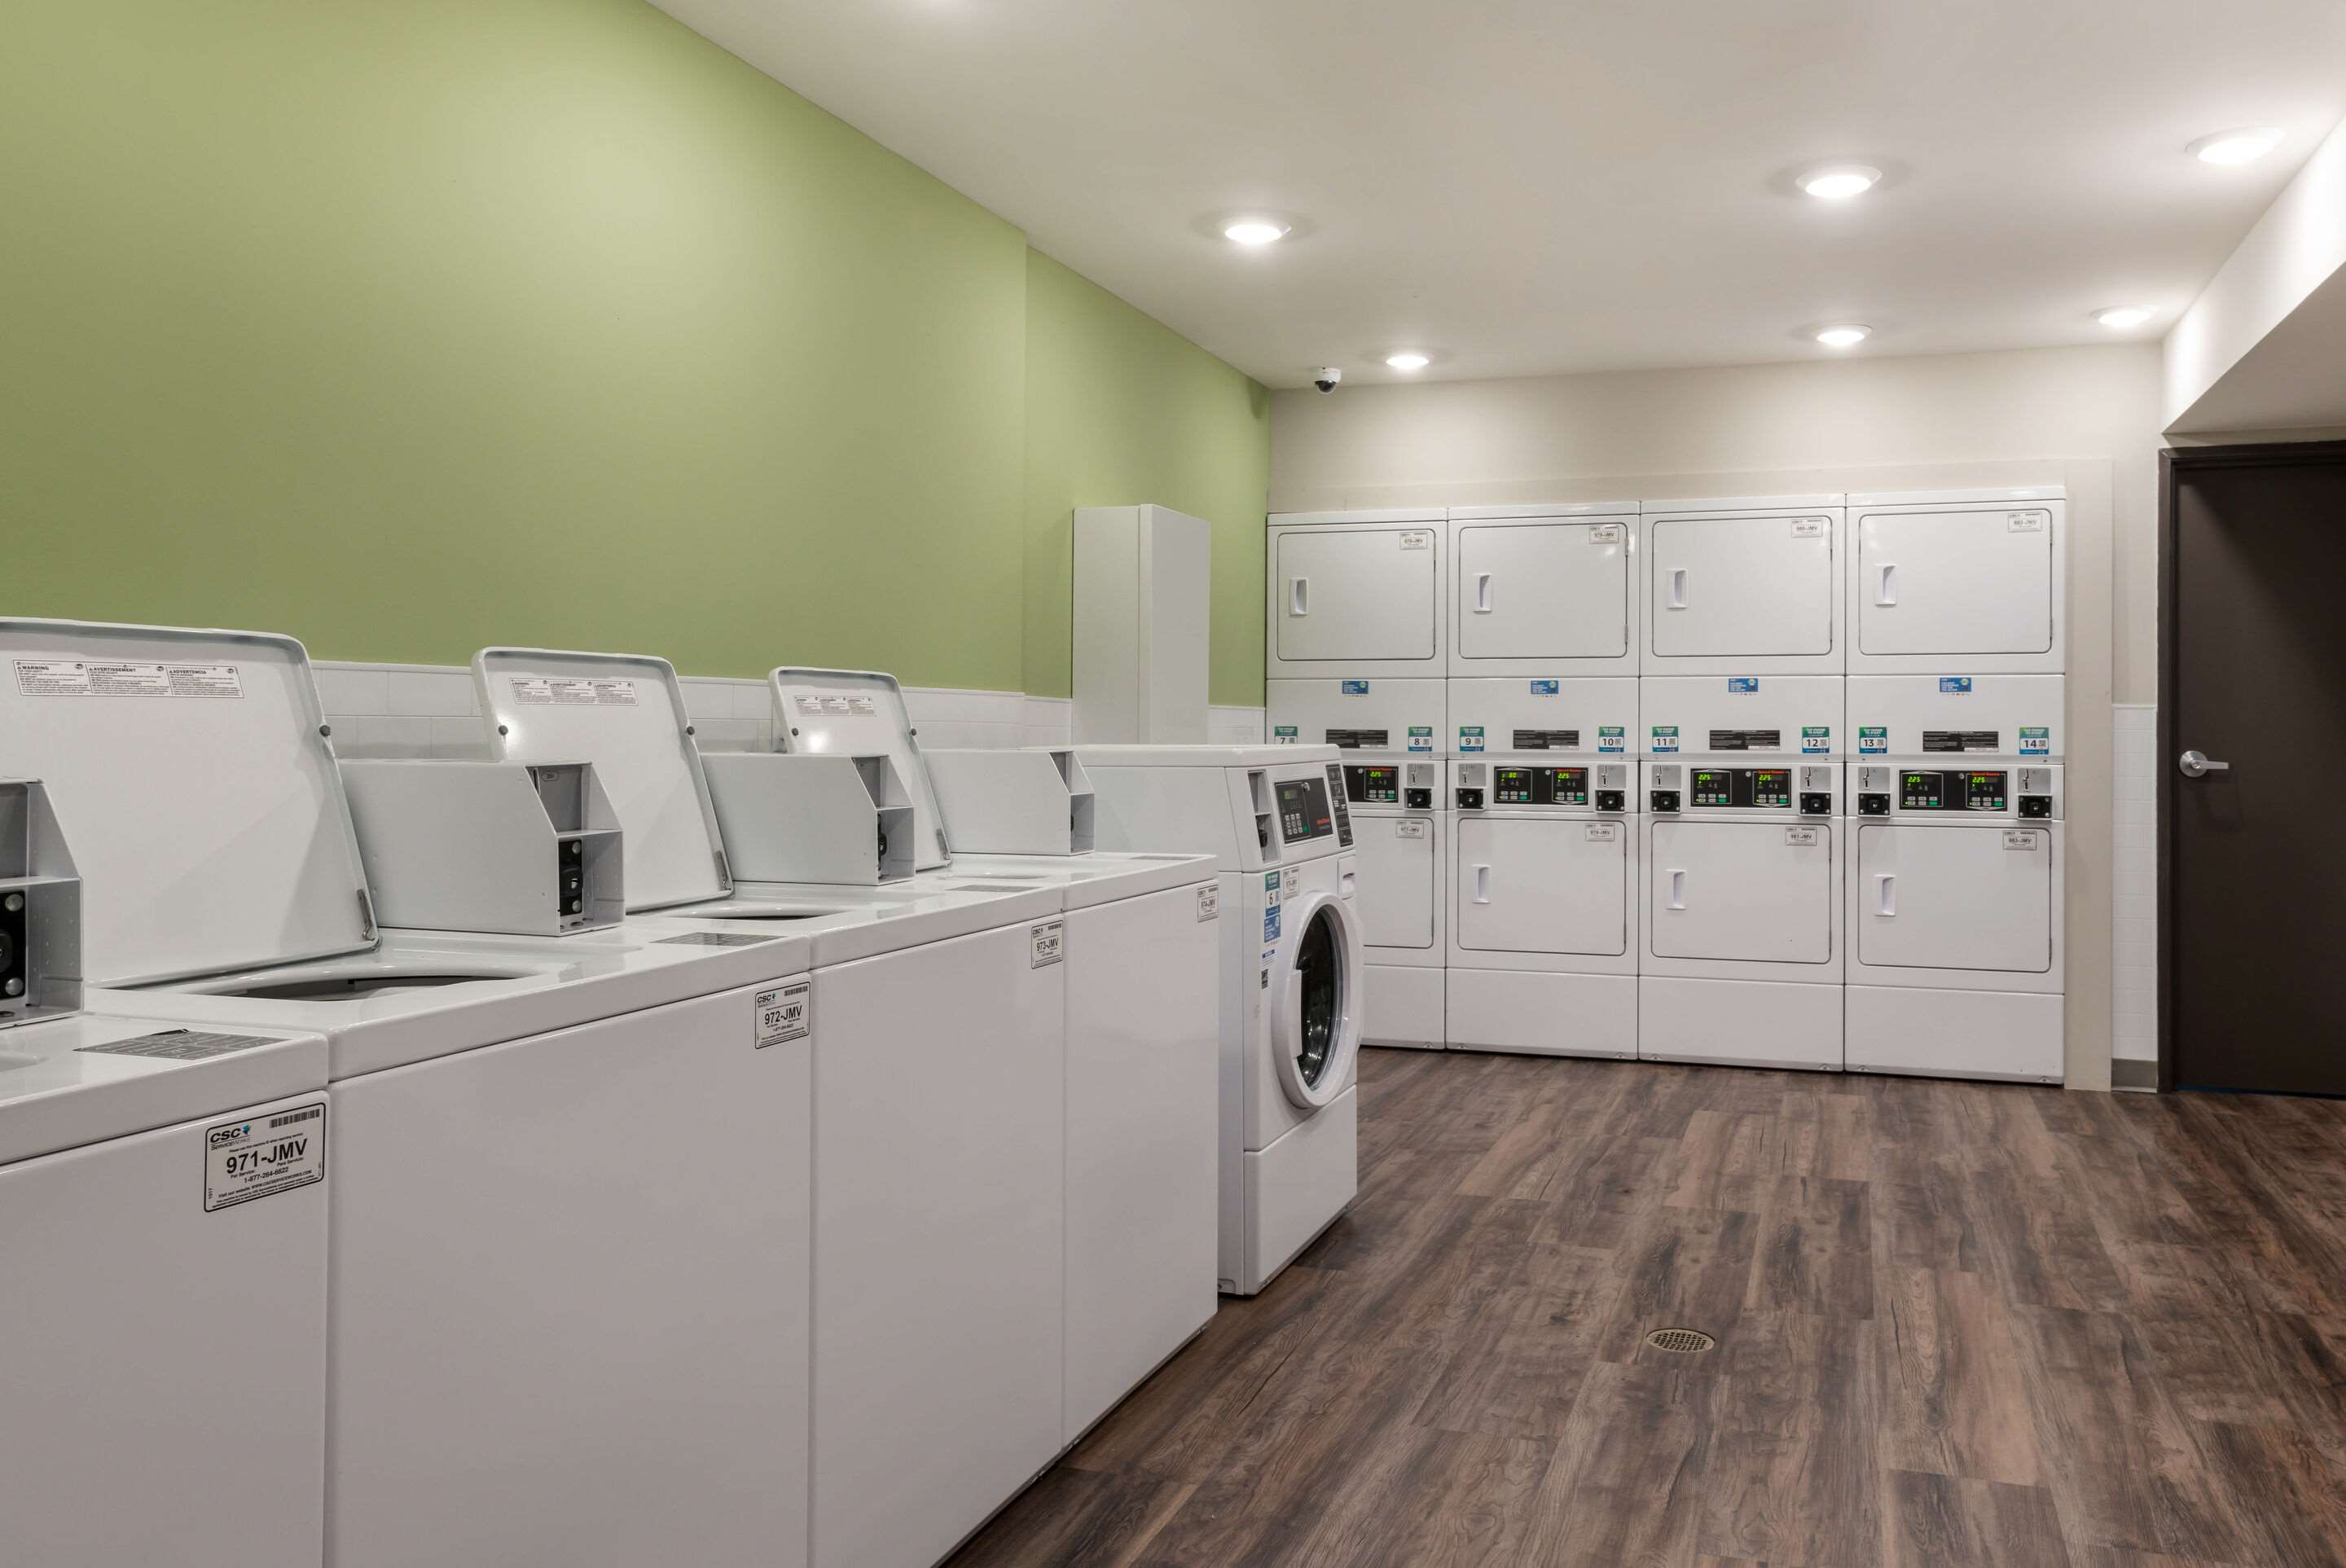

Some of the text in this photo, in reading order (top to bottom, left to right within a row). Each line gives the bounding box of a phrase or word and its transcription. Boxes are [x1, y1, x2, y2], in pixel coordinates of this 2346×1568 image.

[1603, 738, 1614, 746] 10
[1656, 738, 1667, 746] 11
[1806, 739, 1818, 747] 12
[1864, 739, 1874, 747] 13
[2024, 740, 2036, 748] 14
[1269, 892, 1273, 905] 6
[1036, 938, 1059, 951] 973-JMV
[757, 994, 771, 1004] CSC
[764, 1004, 802, 1025] 972-JMV
[210, 1127, 241, 1144] CSC
[226, 1138, 308, 1174] 971-JMV
